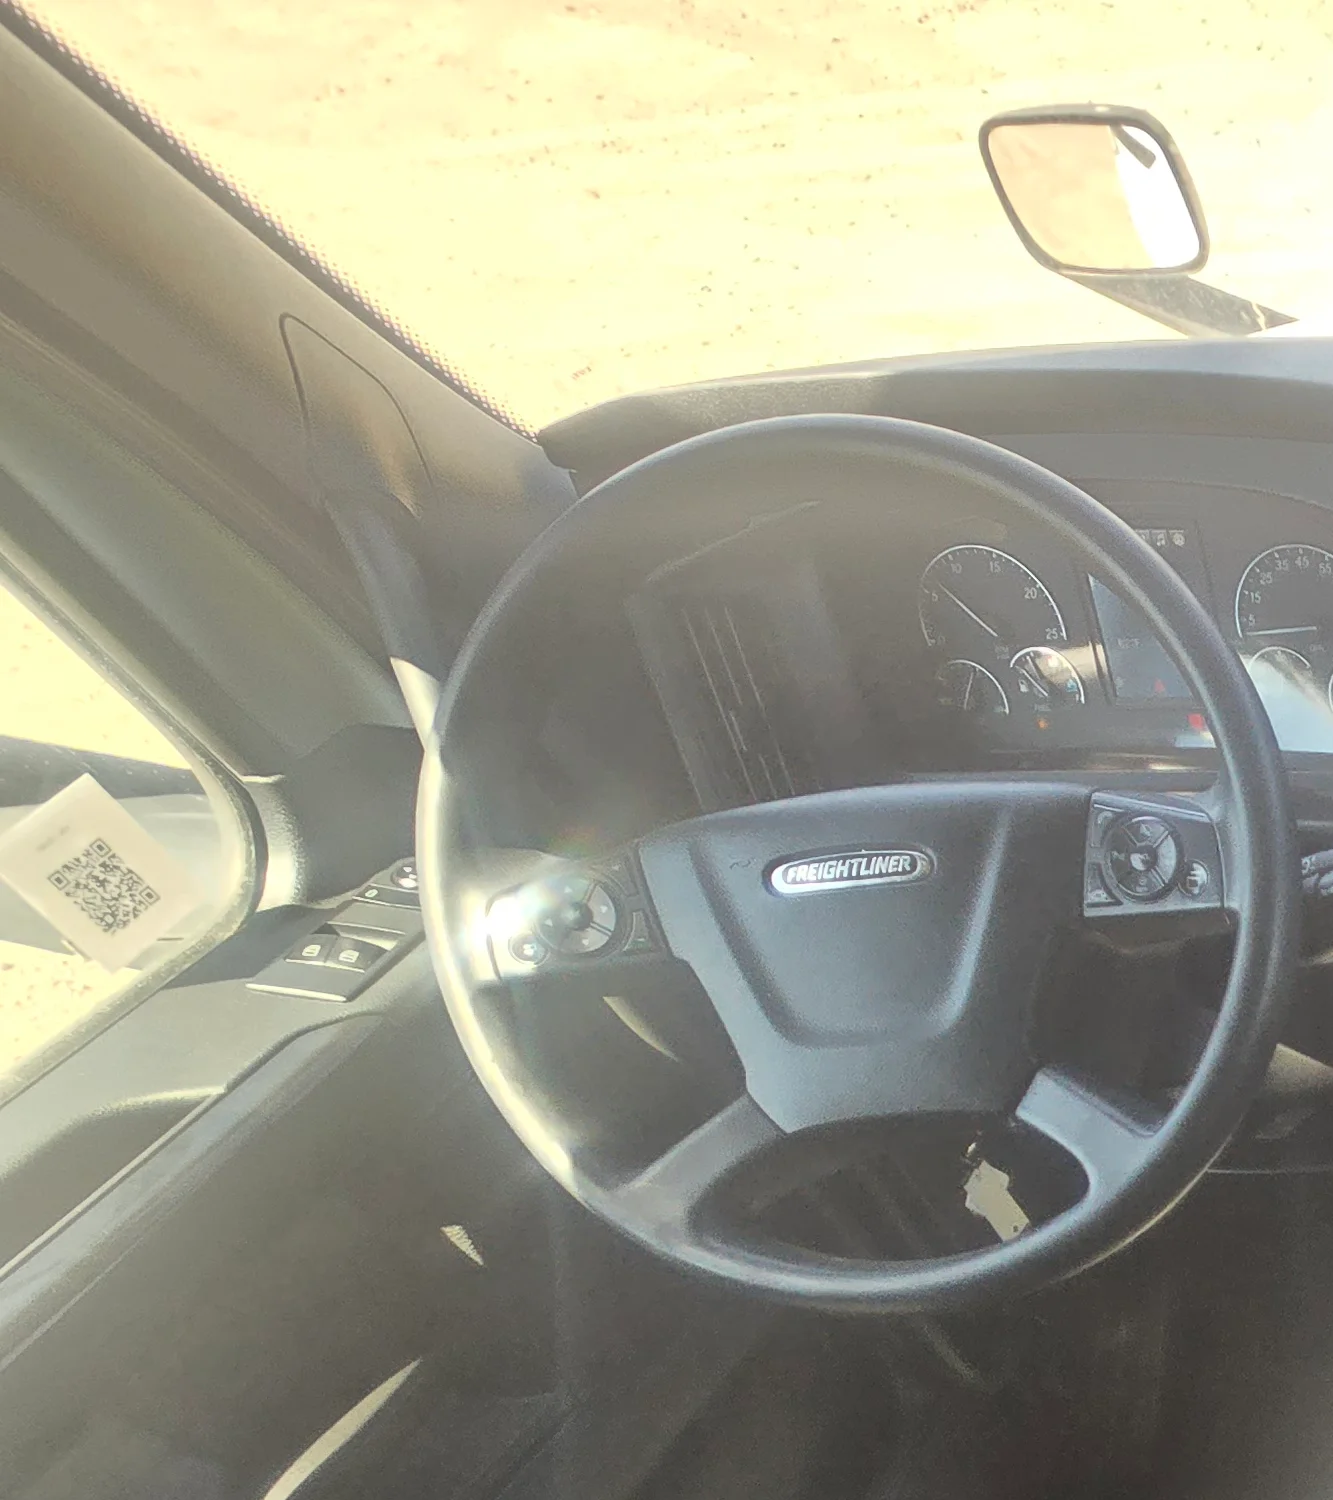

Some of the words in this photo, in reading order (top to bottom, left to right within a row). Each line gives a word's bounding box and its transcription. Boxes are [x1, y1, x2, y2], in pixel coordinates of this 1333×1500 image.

[990, 561, 1001, 572] 15
[1275, 560, 1289, 571] 35
[1295, 556, 1310, 568] 45
[950, 563, 963, 574] 10
[1319, 563, 1332, 575] 55
[1260, 572, 1273, 585] 25
[1025, 587, 1037, 599] 20
[1250, 592, 1261, 604] 15
[1248, 614, 1255, 627] 5
[1045, 628, 1058, 640] 25
[786, 855, 911, 883] FREIGHTLINER
